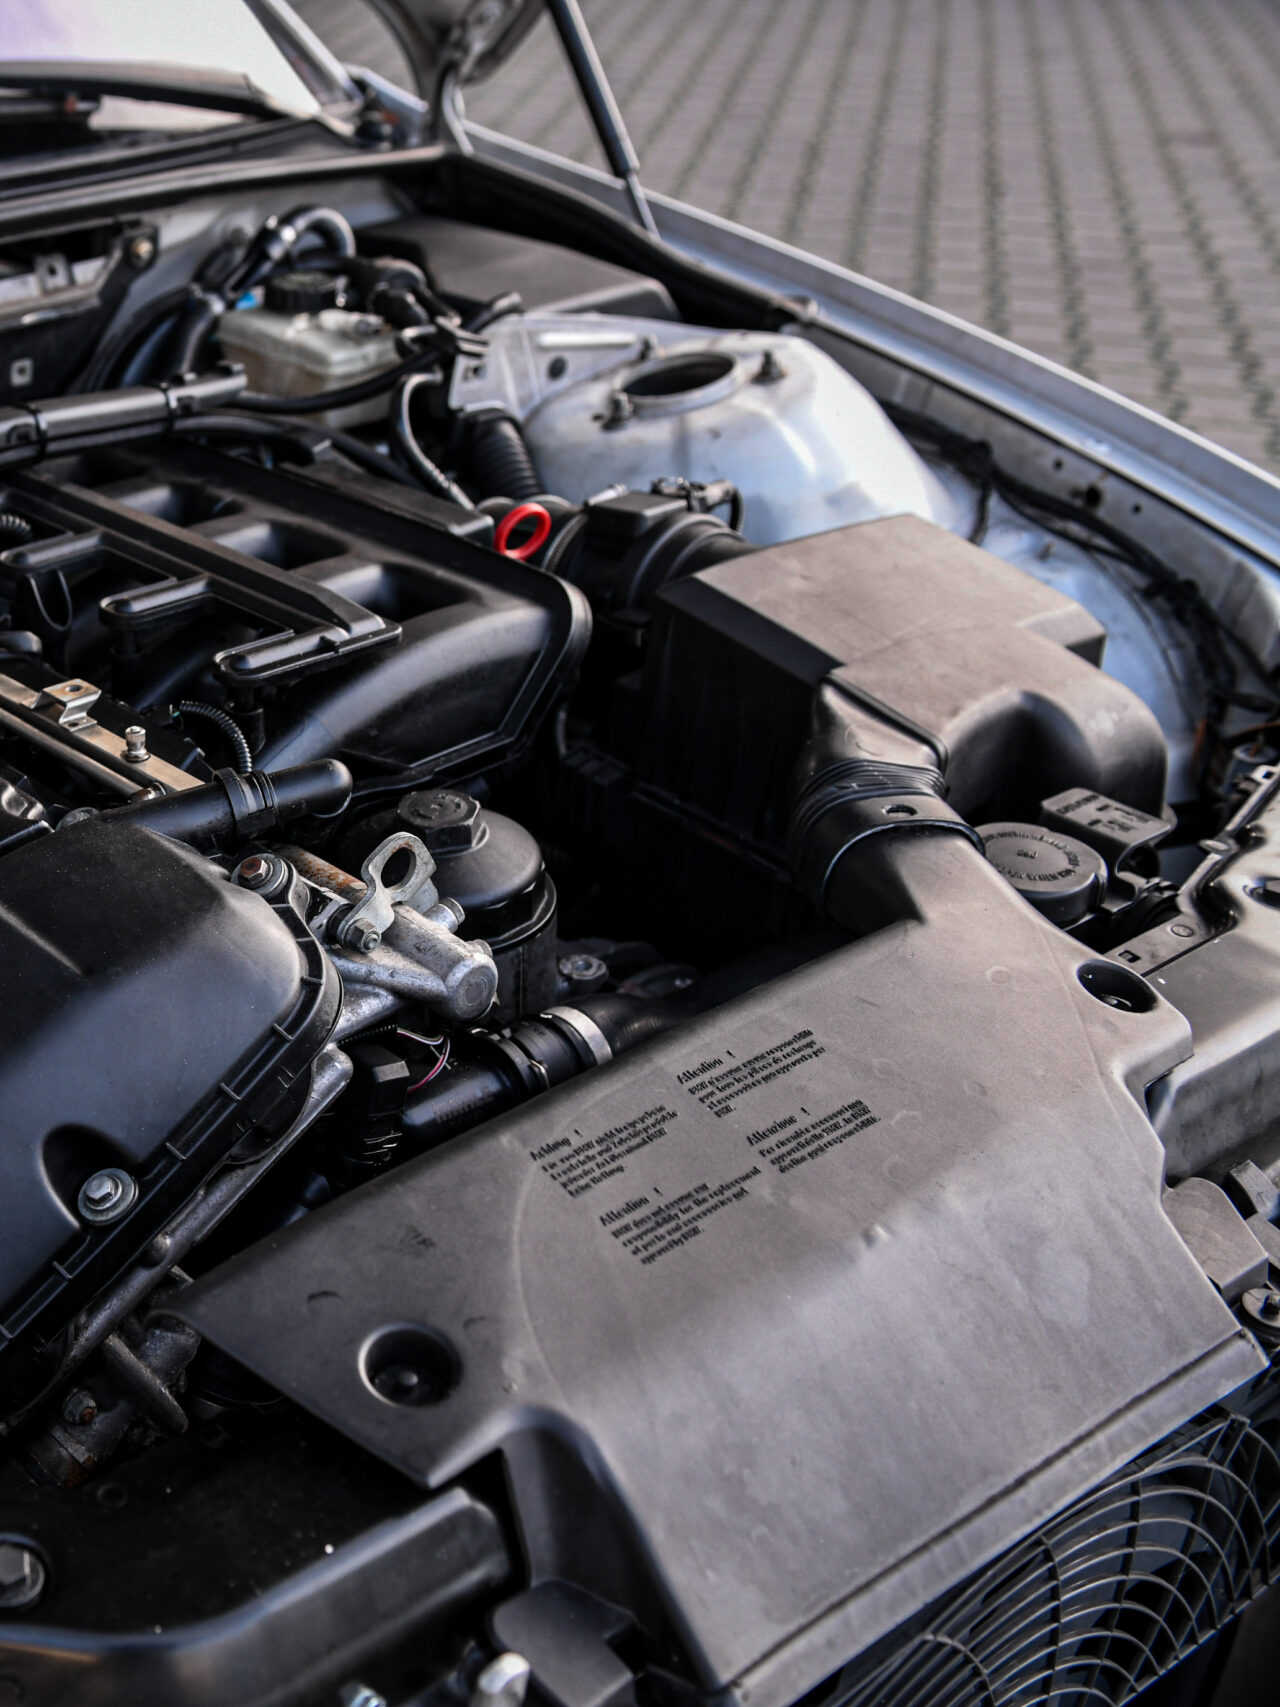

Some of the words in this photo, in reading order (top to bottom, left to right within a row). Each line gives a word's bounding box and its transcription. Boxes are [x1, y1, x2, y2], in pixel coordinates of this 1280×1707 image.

[677, 1058, 723, 1084] Attention
[747, 1115, 797, 1146] Attenzione
[530, 1137, 571, 1161] Achtung
[600, 1197, 649, 1226] Attention
